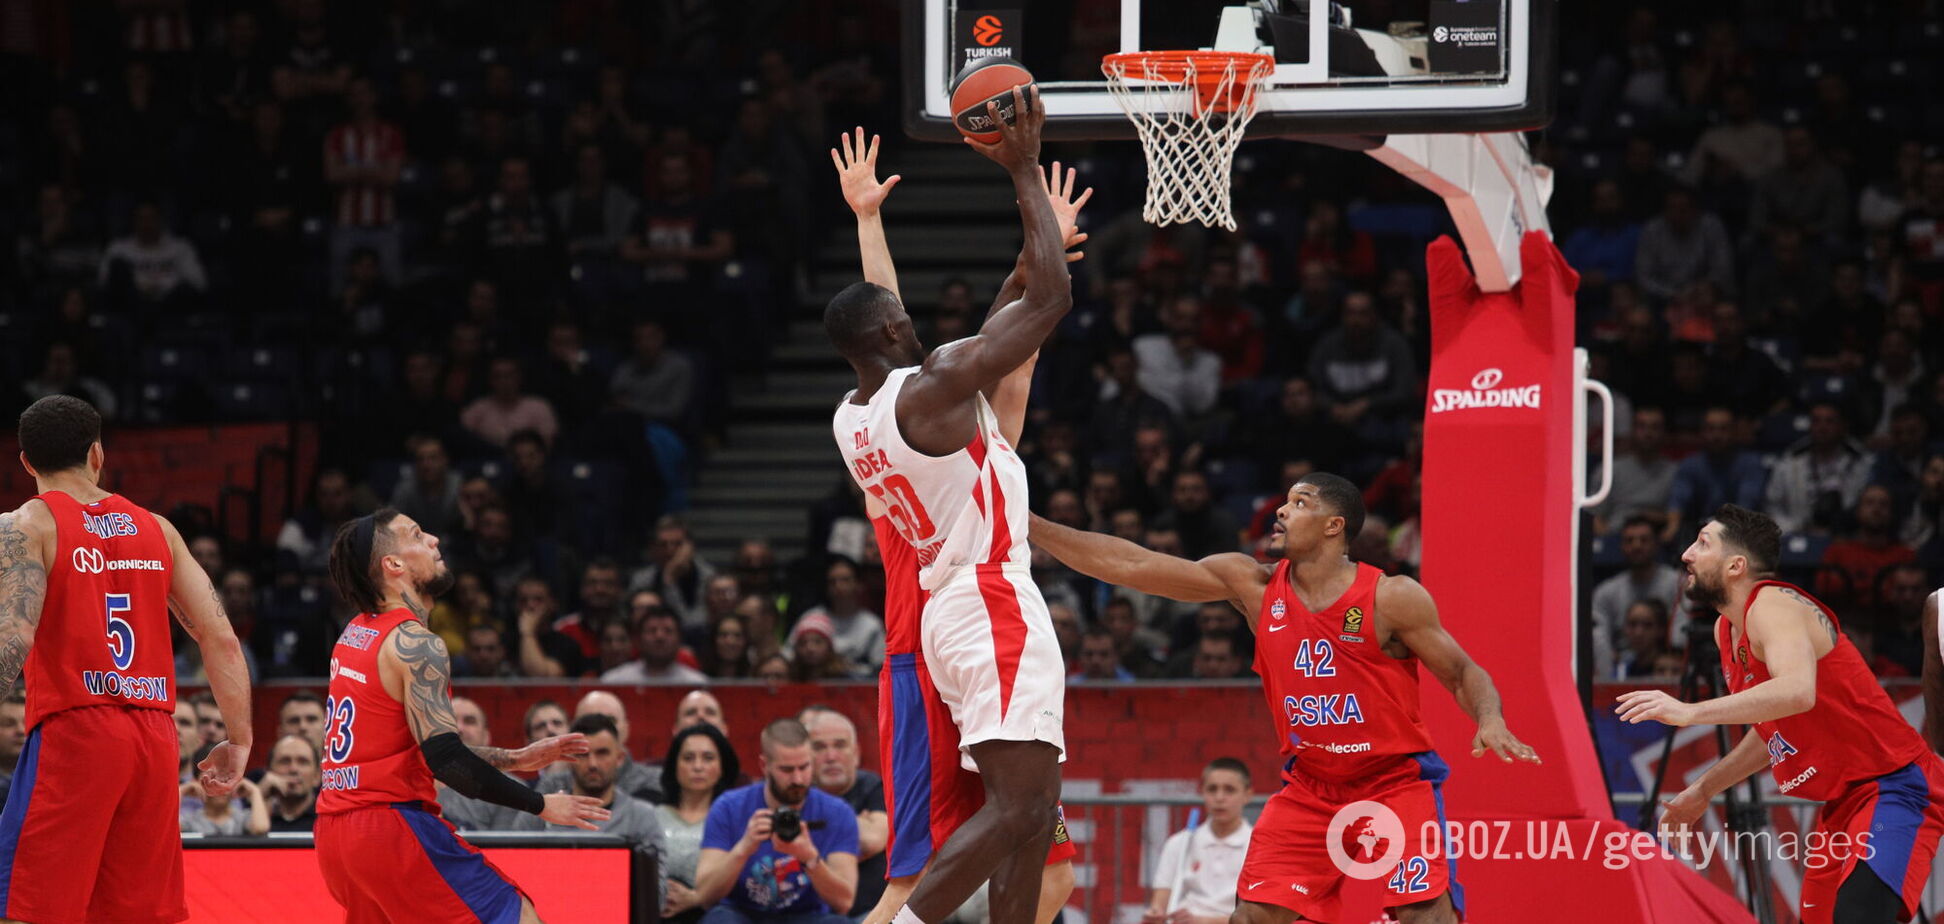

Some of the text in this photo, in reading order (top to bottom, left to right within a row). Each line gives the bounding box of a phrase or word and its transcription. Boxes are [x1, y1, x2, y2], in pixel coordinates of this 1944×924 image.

[965, 47, 1012, 58] TURKISH
[1450, 31, 1497, 42] oneteam
[1432, 384, 1540, 413] SPALDING
[105, 592, 135, 671] 5
[1294, 639, 1336, 678] 42
[83, 671, 168, 701] MOSCOW
[1284, 693, 1364, 727] CSKA
[1388, 856, 1430, 894] 42
